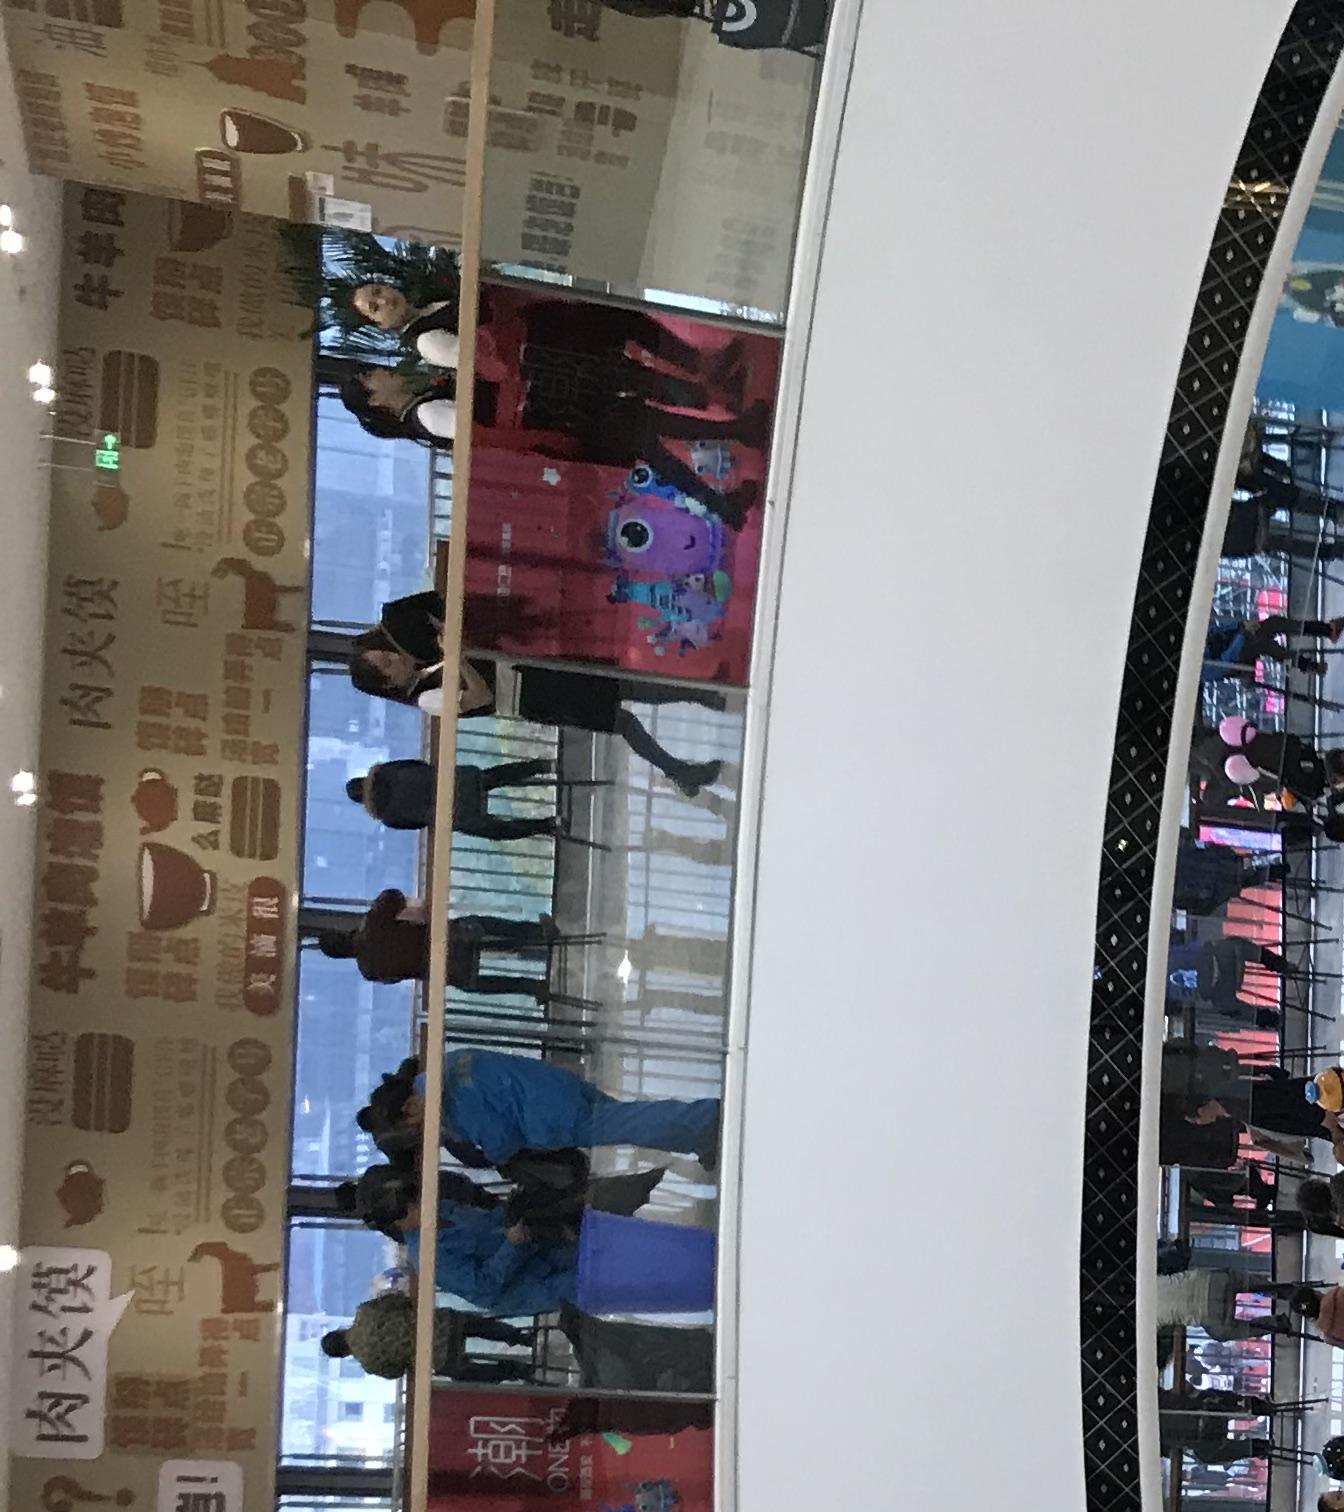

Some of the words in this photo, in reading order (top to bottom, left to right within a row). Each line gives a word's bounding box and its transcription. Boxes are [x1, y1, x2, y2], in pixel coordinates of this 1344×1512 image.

[58, 574, 118, 729] 肉夹馍
[24, 1261, 98, 1442] 肉夹馍
[466, 1415, 545, 1480] 潮
